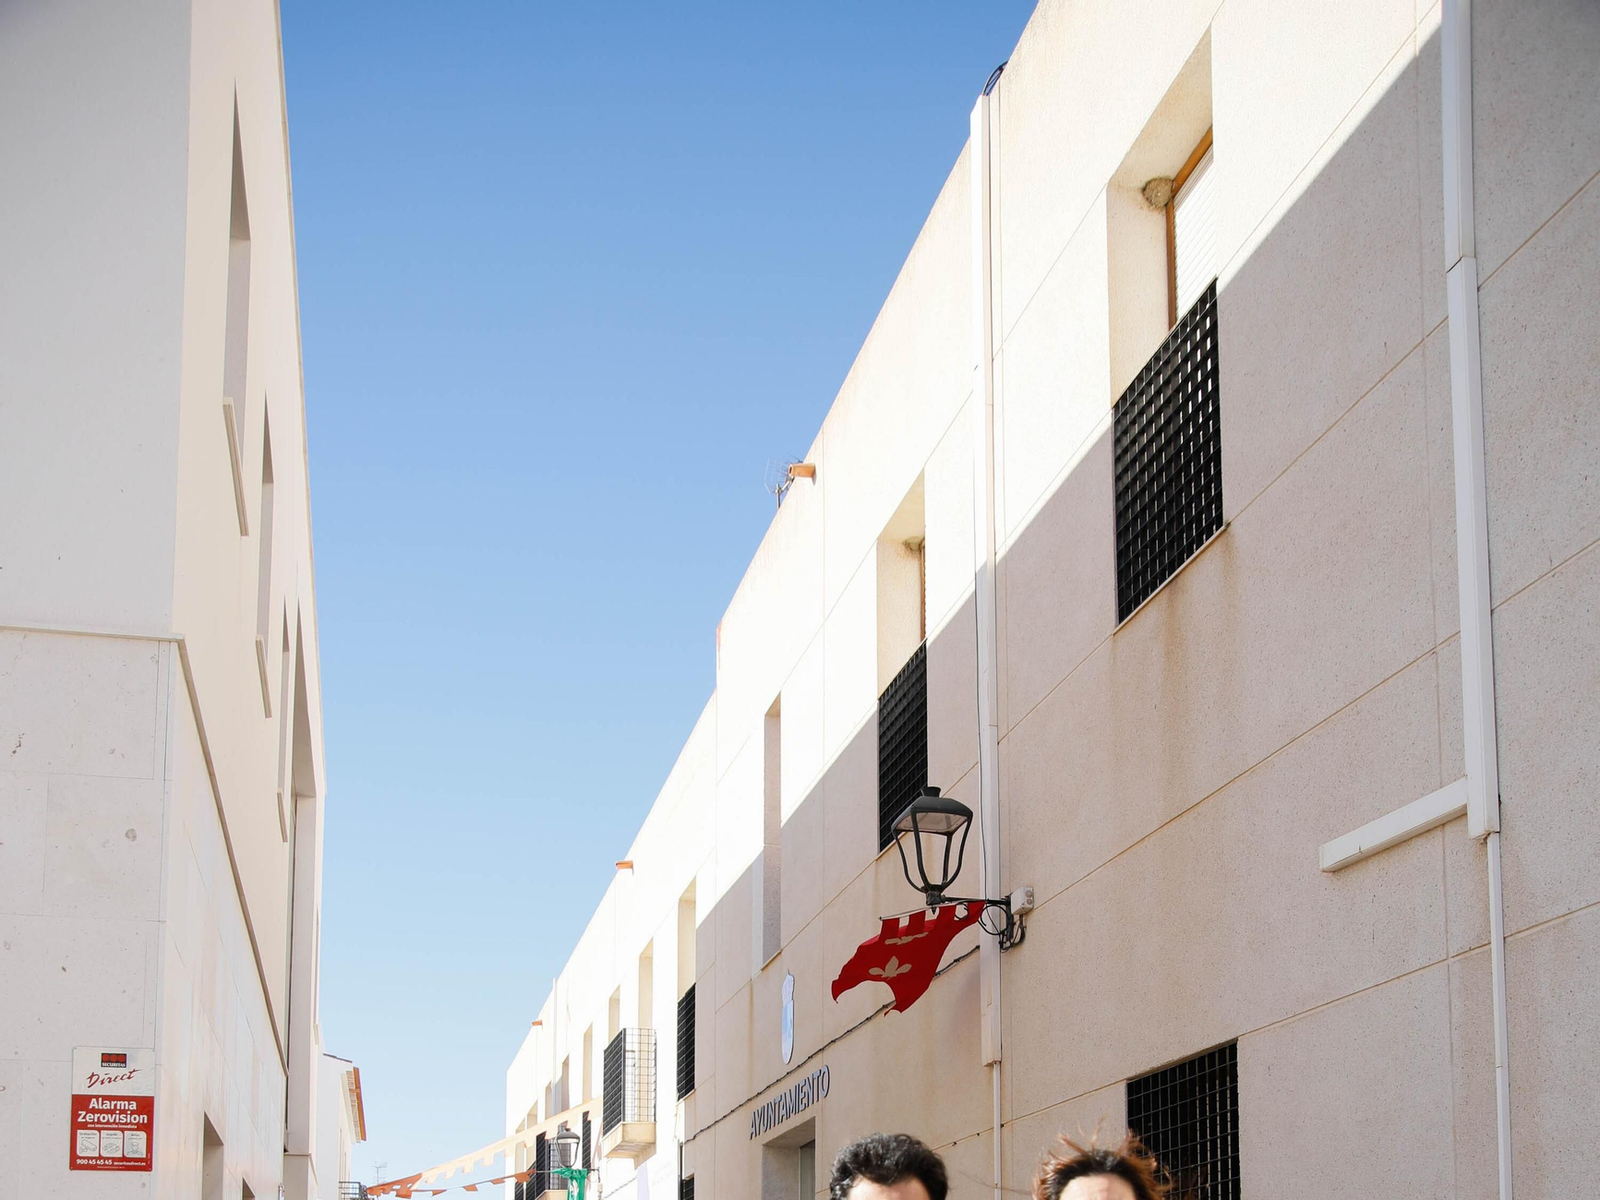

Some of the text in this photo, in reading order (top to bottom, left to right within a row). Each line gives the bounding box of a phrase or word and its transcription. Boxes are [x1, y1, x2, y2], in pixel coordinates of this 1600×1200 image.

[86, 1068, 142, 1088] Direct
[89, 1097, 137, 1110] Alarma
[749, 1065, 831, 1140] AYUNTAMIENTO
[77, 1110, 148, 1124] Zerovision
